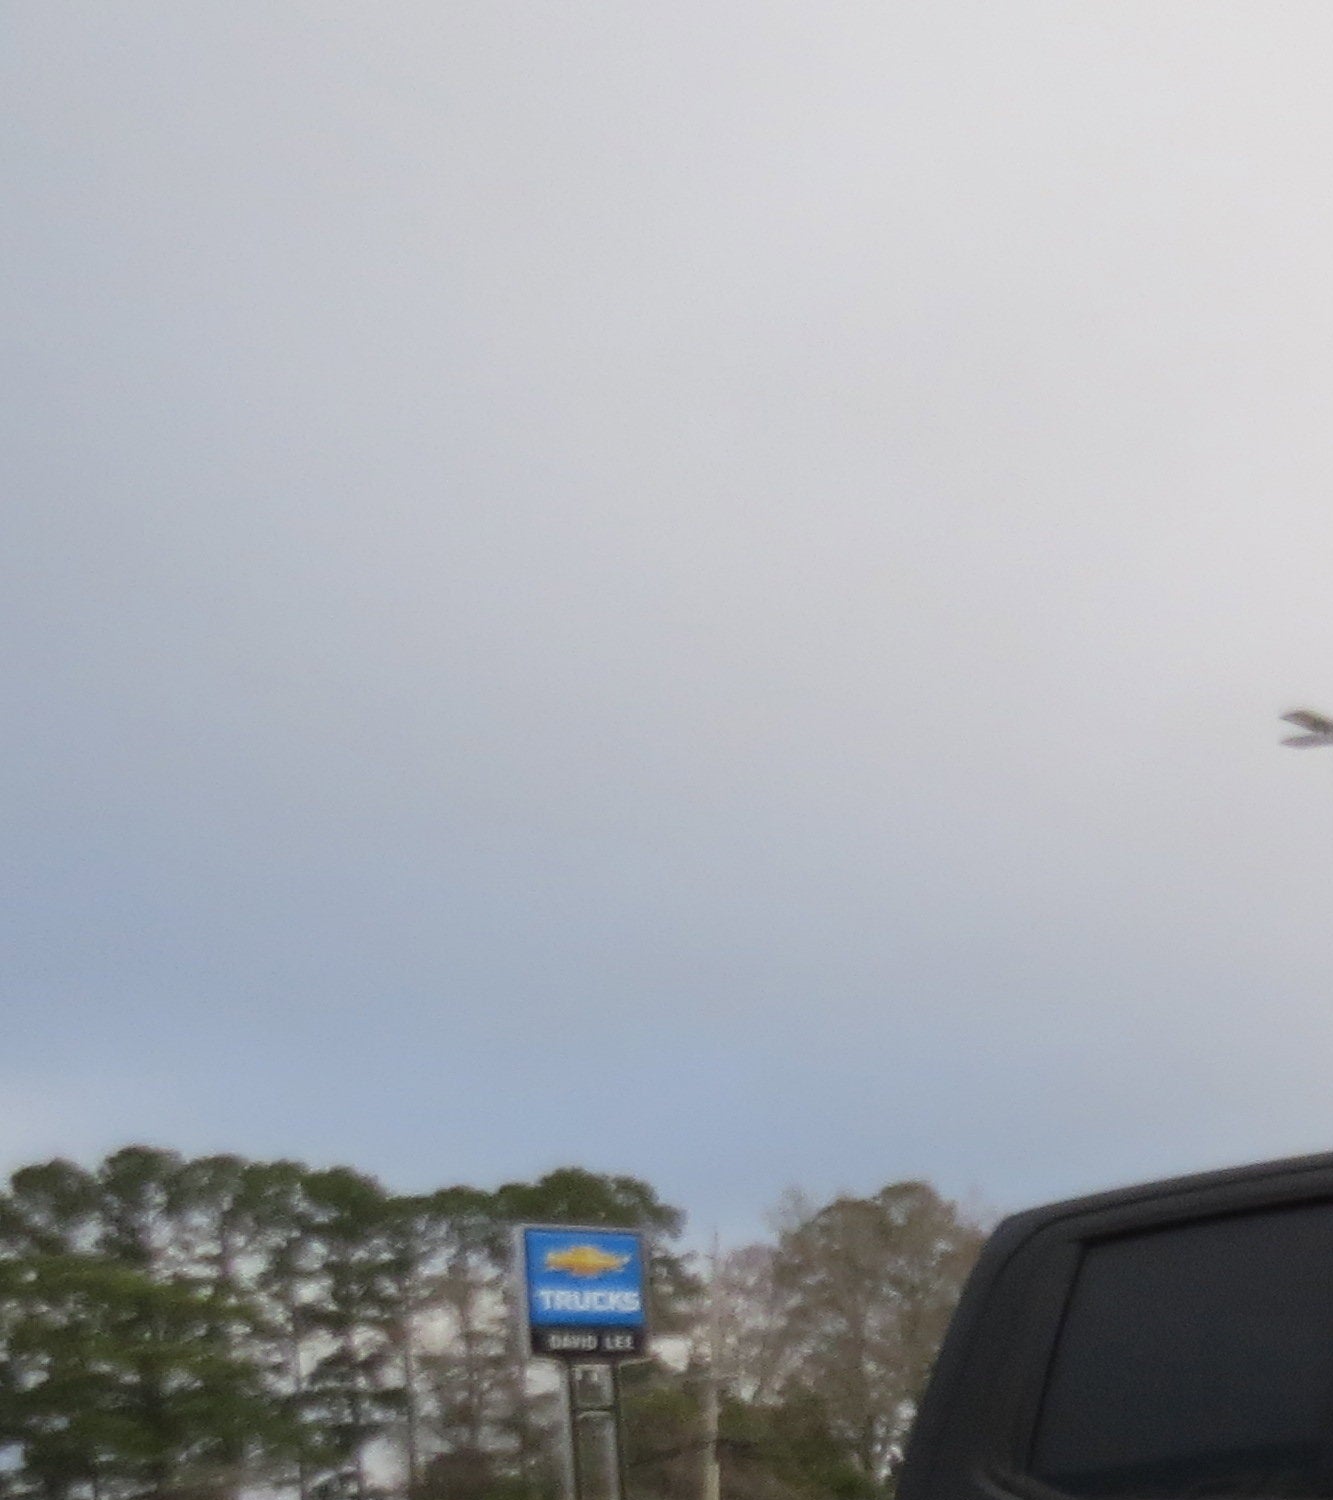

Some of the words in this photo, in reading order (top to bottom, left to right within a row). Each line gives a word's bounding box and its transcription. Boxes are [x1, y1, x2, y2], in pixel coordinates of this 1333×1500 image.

[538, 1289, 641, 1312] TRUCKS
[549, 1334, 598, 1349] DAVID
[605, 1335, 635, 1350] LEE
